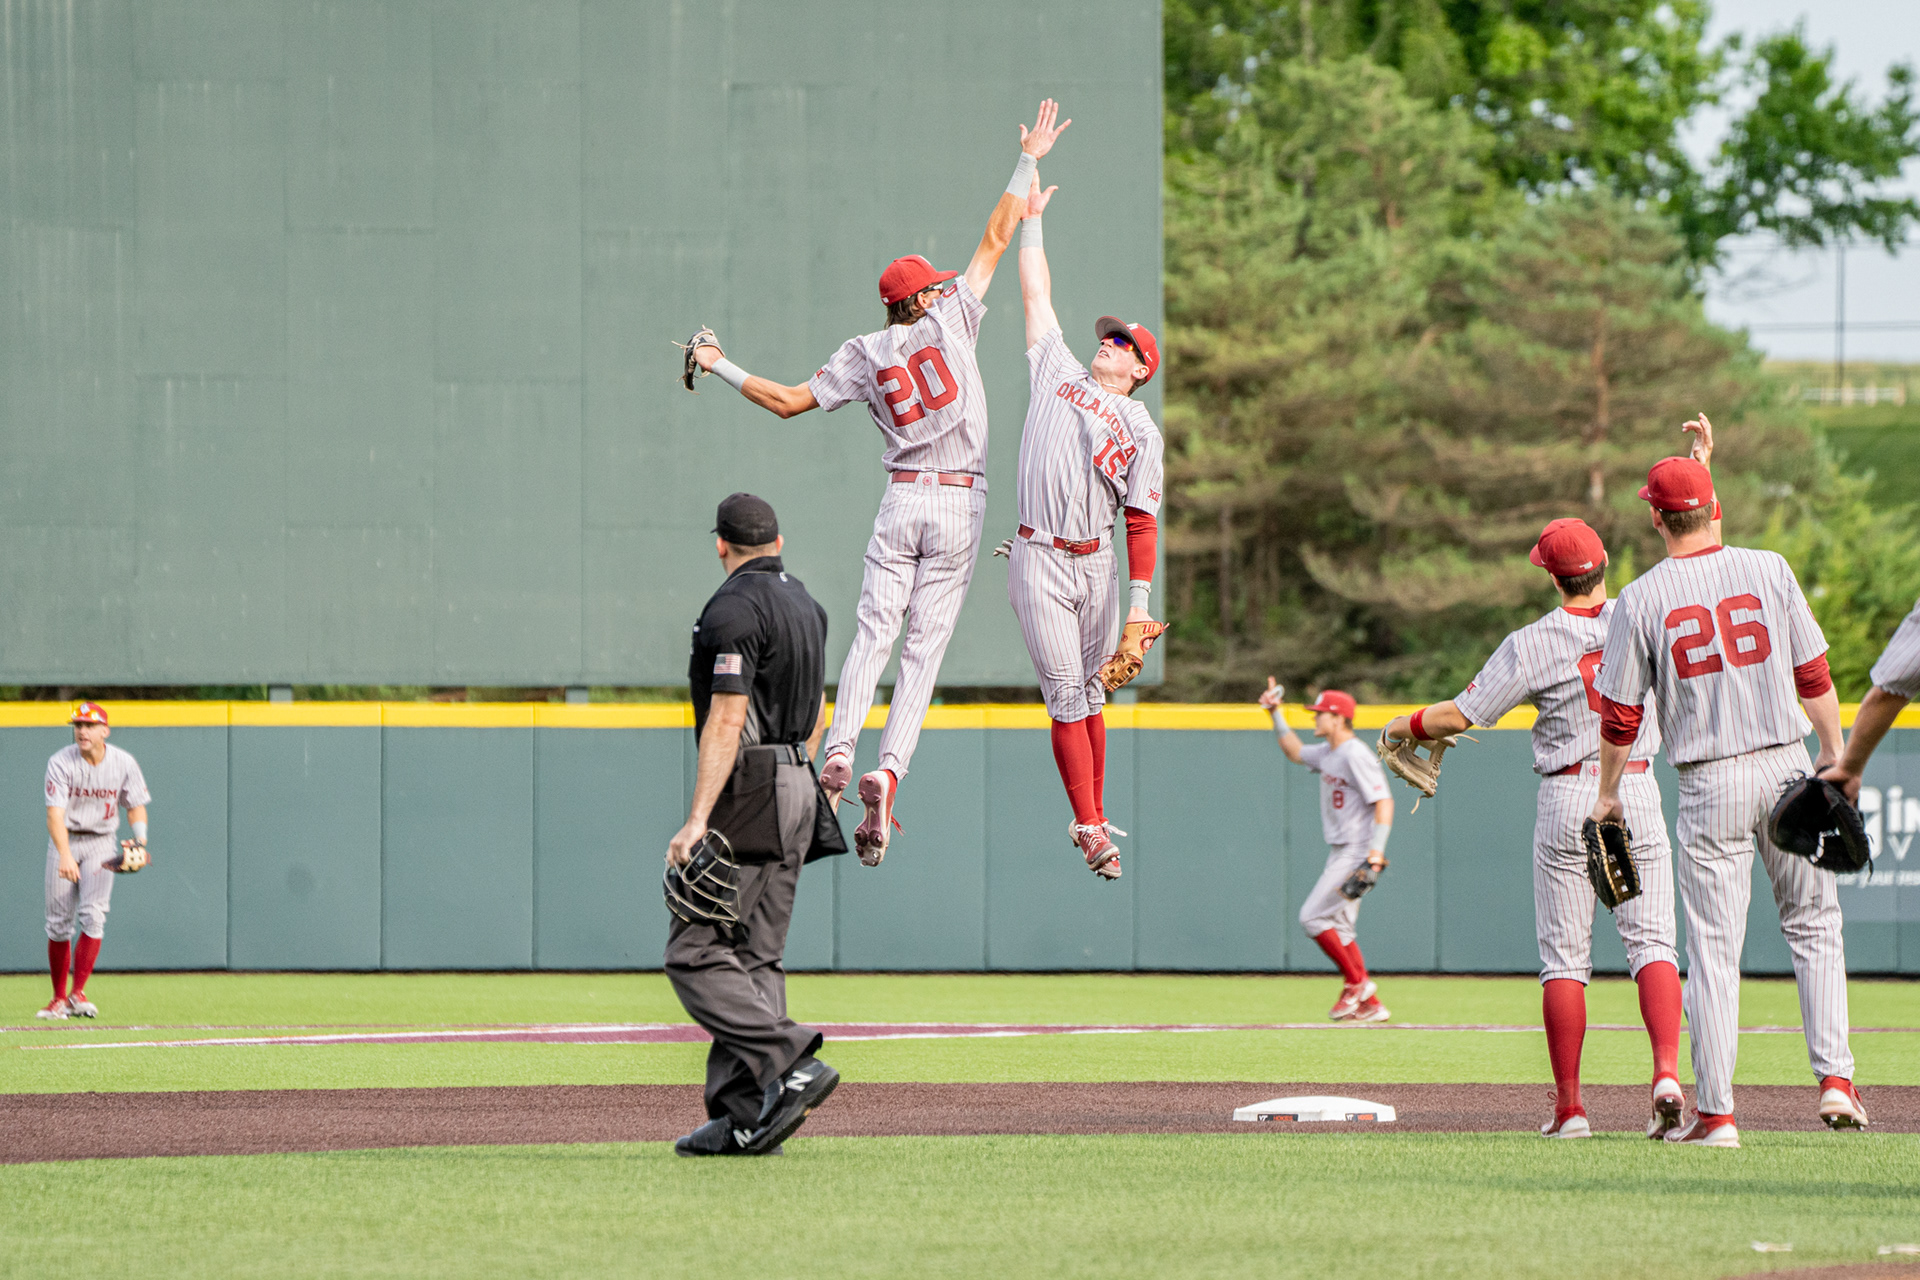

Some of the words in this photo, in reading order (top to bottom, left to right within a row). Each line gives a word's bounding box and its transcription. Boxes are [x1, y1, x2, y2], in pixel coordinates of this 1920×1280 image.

[876, 346, 958, 427] 20
[1056, 382, 1137, 460] OKLAHOMA
[1093, 438, 1128, 480] 15
[1665, 593, 1772, 680] 26
[1333, 790, 1344, 809] 8
[785, 1070, 813, 1092] N
[733, 1128, 752, 1148] N
